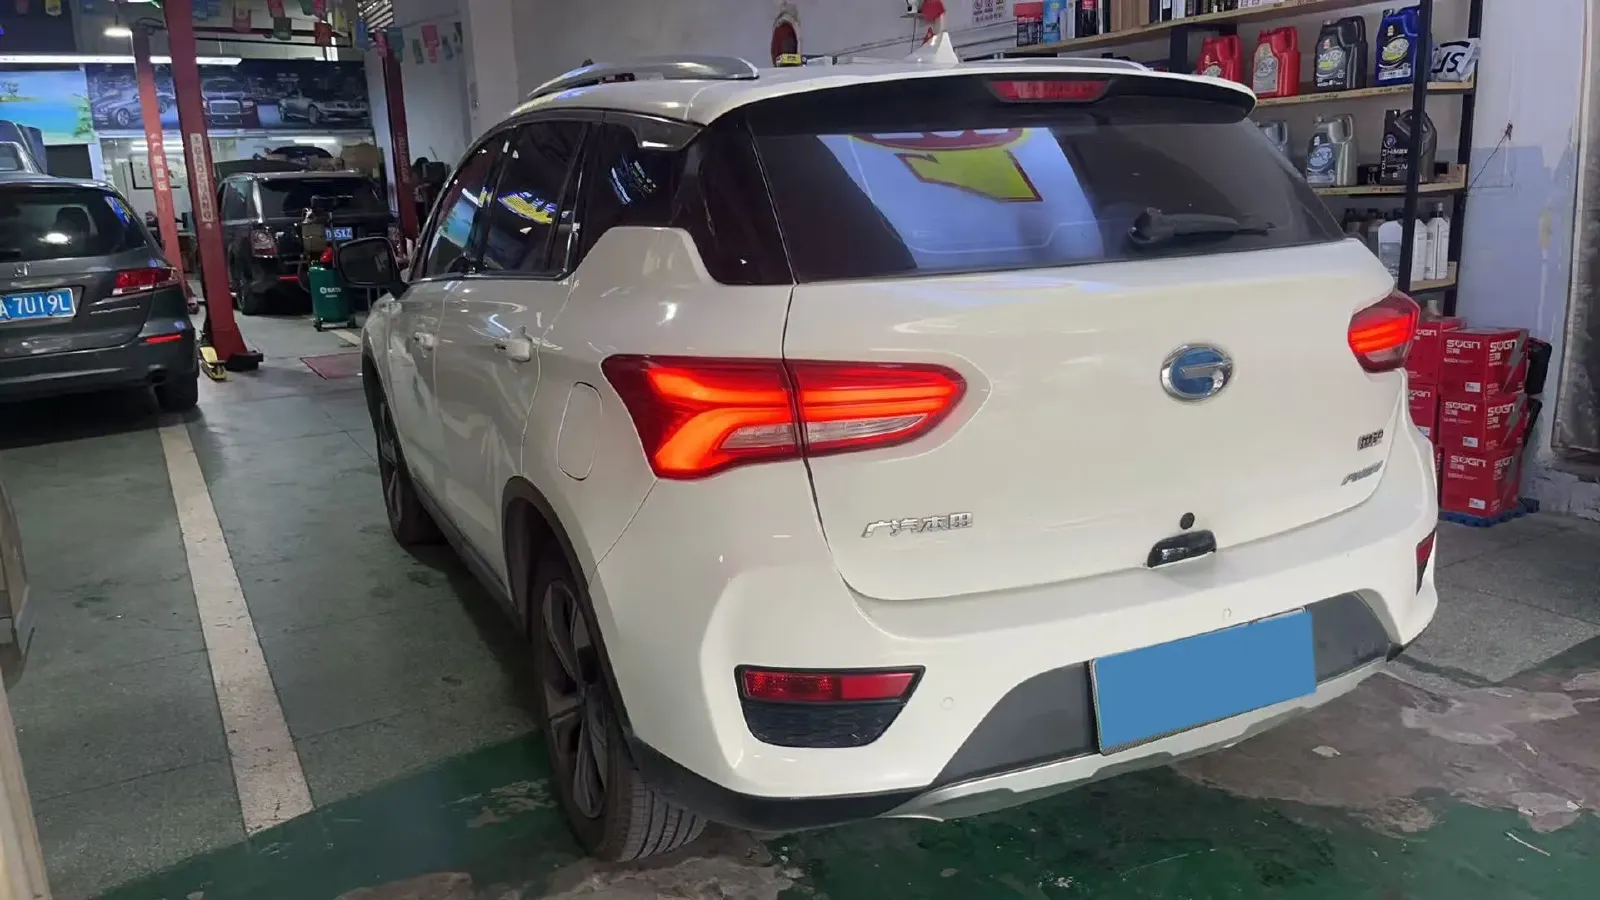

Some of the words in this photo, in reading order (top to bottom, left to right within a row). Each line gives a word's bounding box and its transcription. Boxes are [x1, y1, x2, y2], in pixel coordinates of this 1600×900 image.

[1446, 339, 1481, 350] SOGN
[1489, 339, 1518, 353] SOGN
[1445, 401, 1478, 412] SOGN
[1487, 403, 1516, 417] SOGN
[1450, 455, 1488, 468] SOGN
